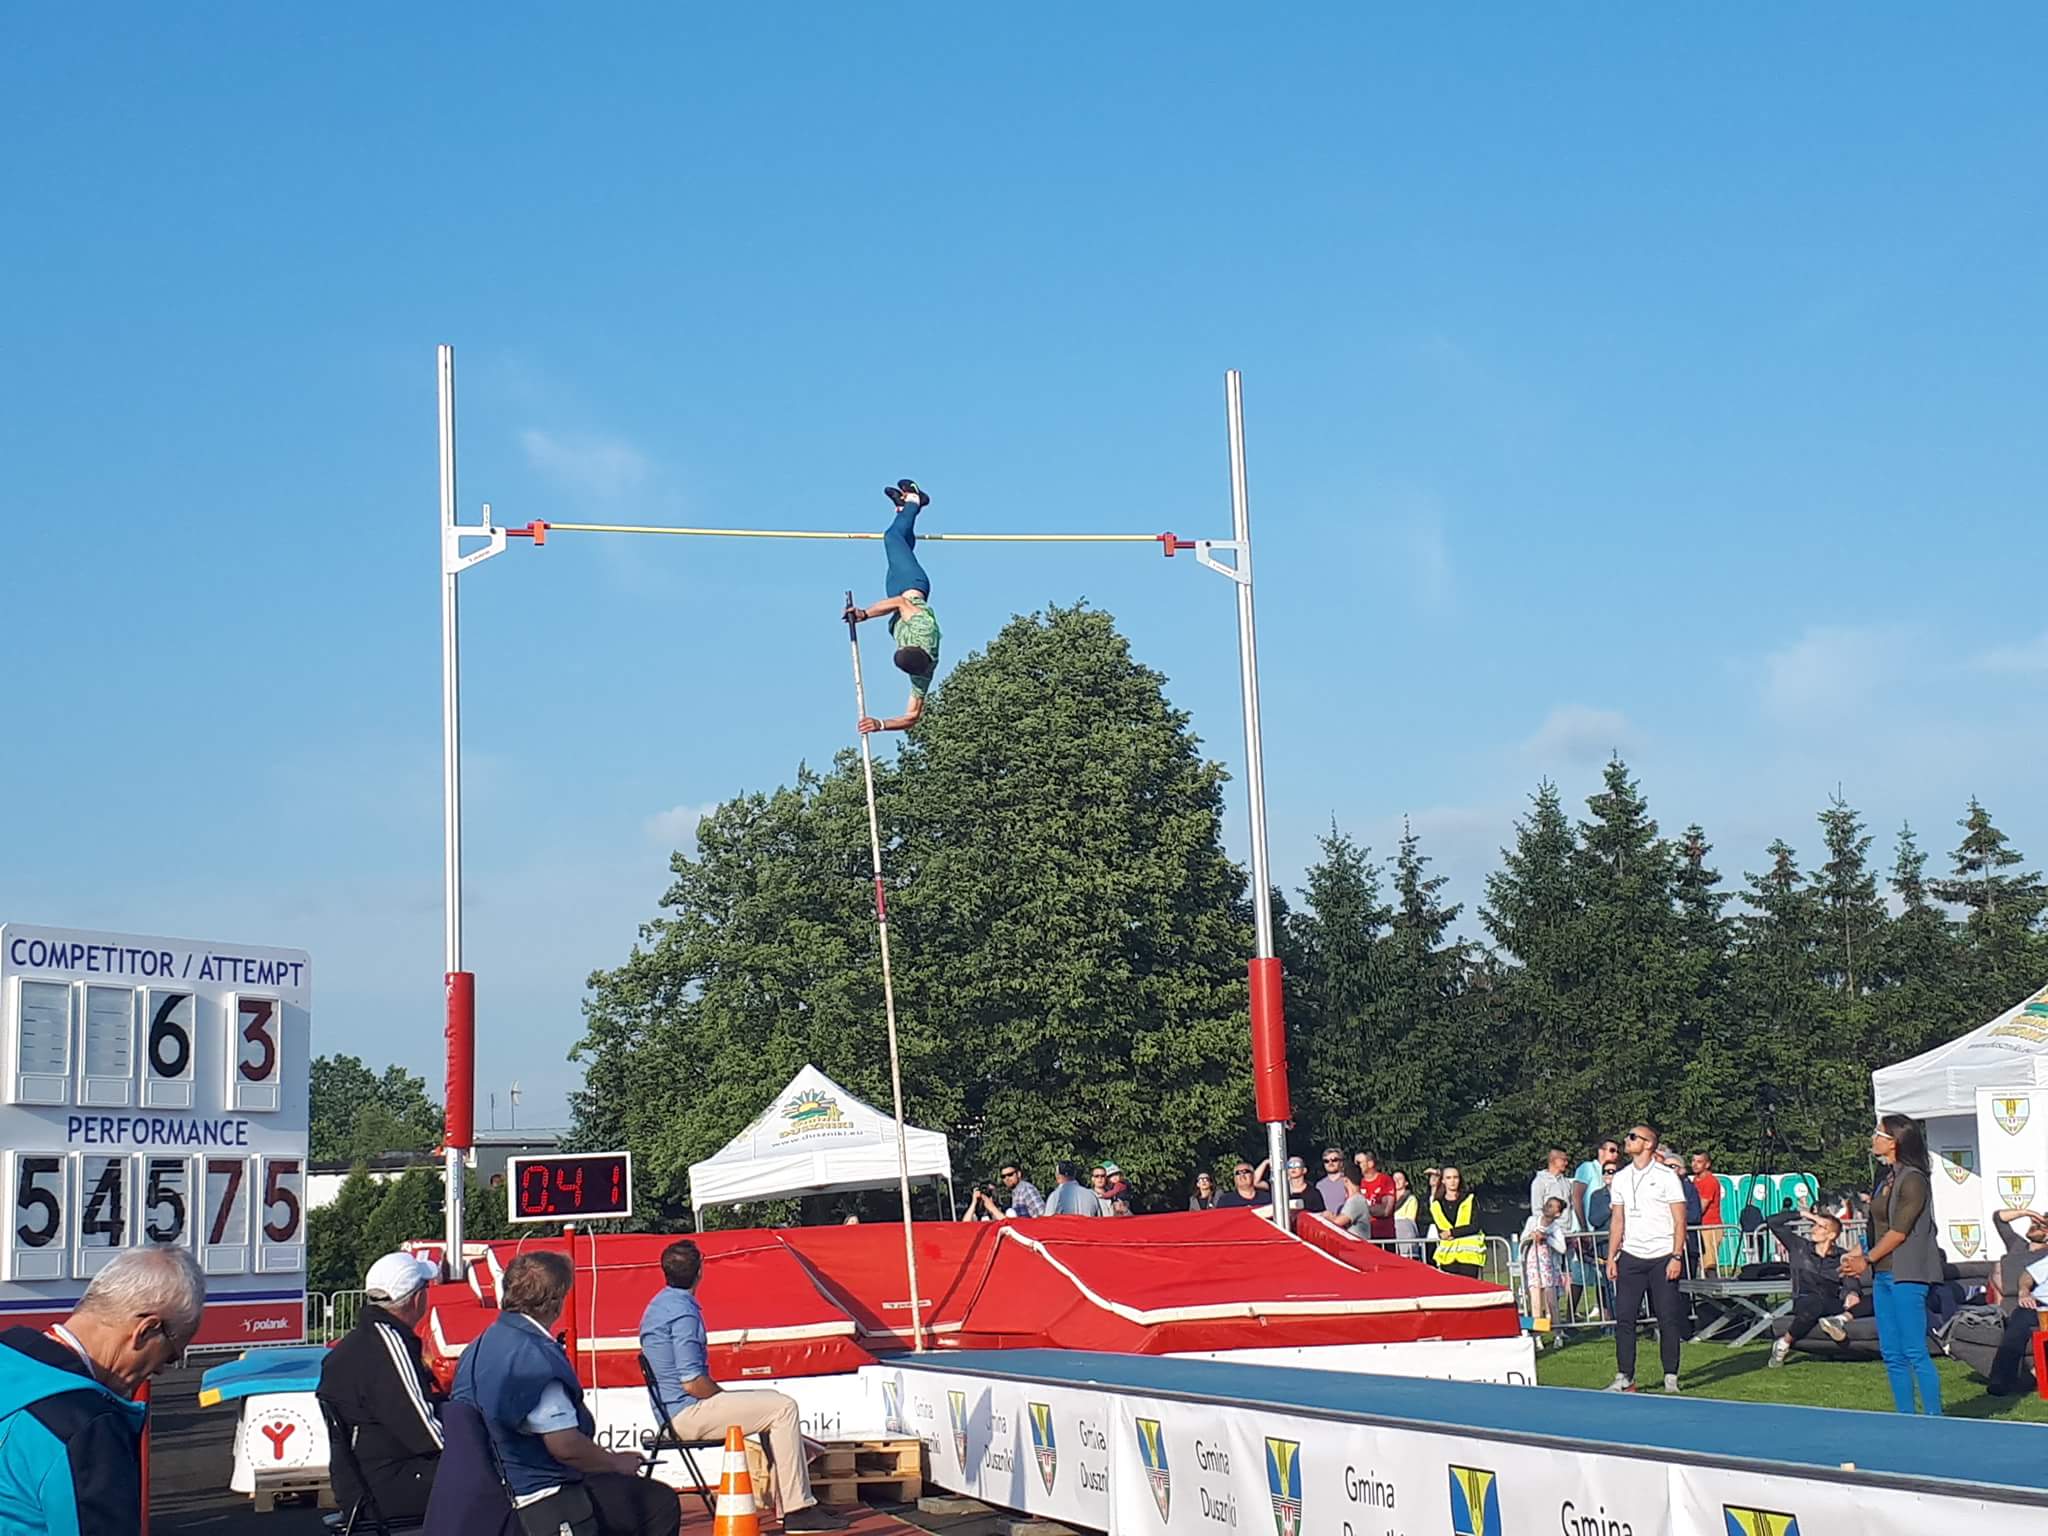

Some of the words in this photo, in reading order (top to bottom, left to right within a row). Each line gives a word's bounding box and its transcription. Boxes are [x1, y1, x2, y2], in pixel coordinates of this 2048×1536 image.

[10, 938, 175, 978] COMPETITOR
[182, 953, 193, 978] /
[199, 955, 304, 987] ATTEMPT
[148, 994, 190, 1078] 6
[238, 1000, 275, 1082] 3
[67, 1115, 249, 1147] PERFORMANCE
[252, 1317, 290, 1333] polanik
[1079, 1419, 1107, 1450] Gmina
[1195, 1439, 1230, 1475] Gmina
[1344, 1465, 1395, 1508] Gmina
